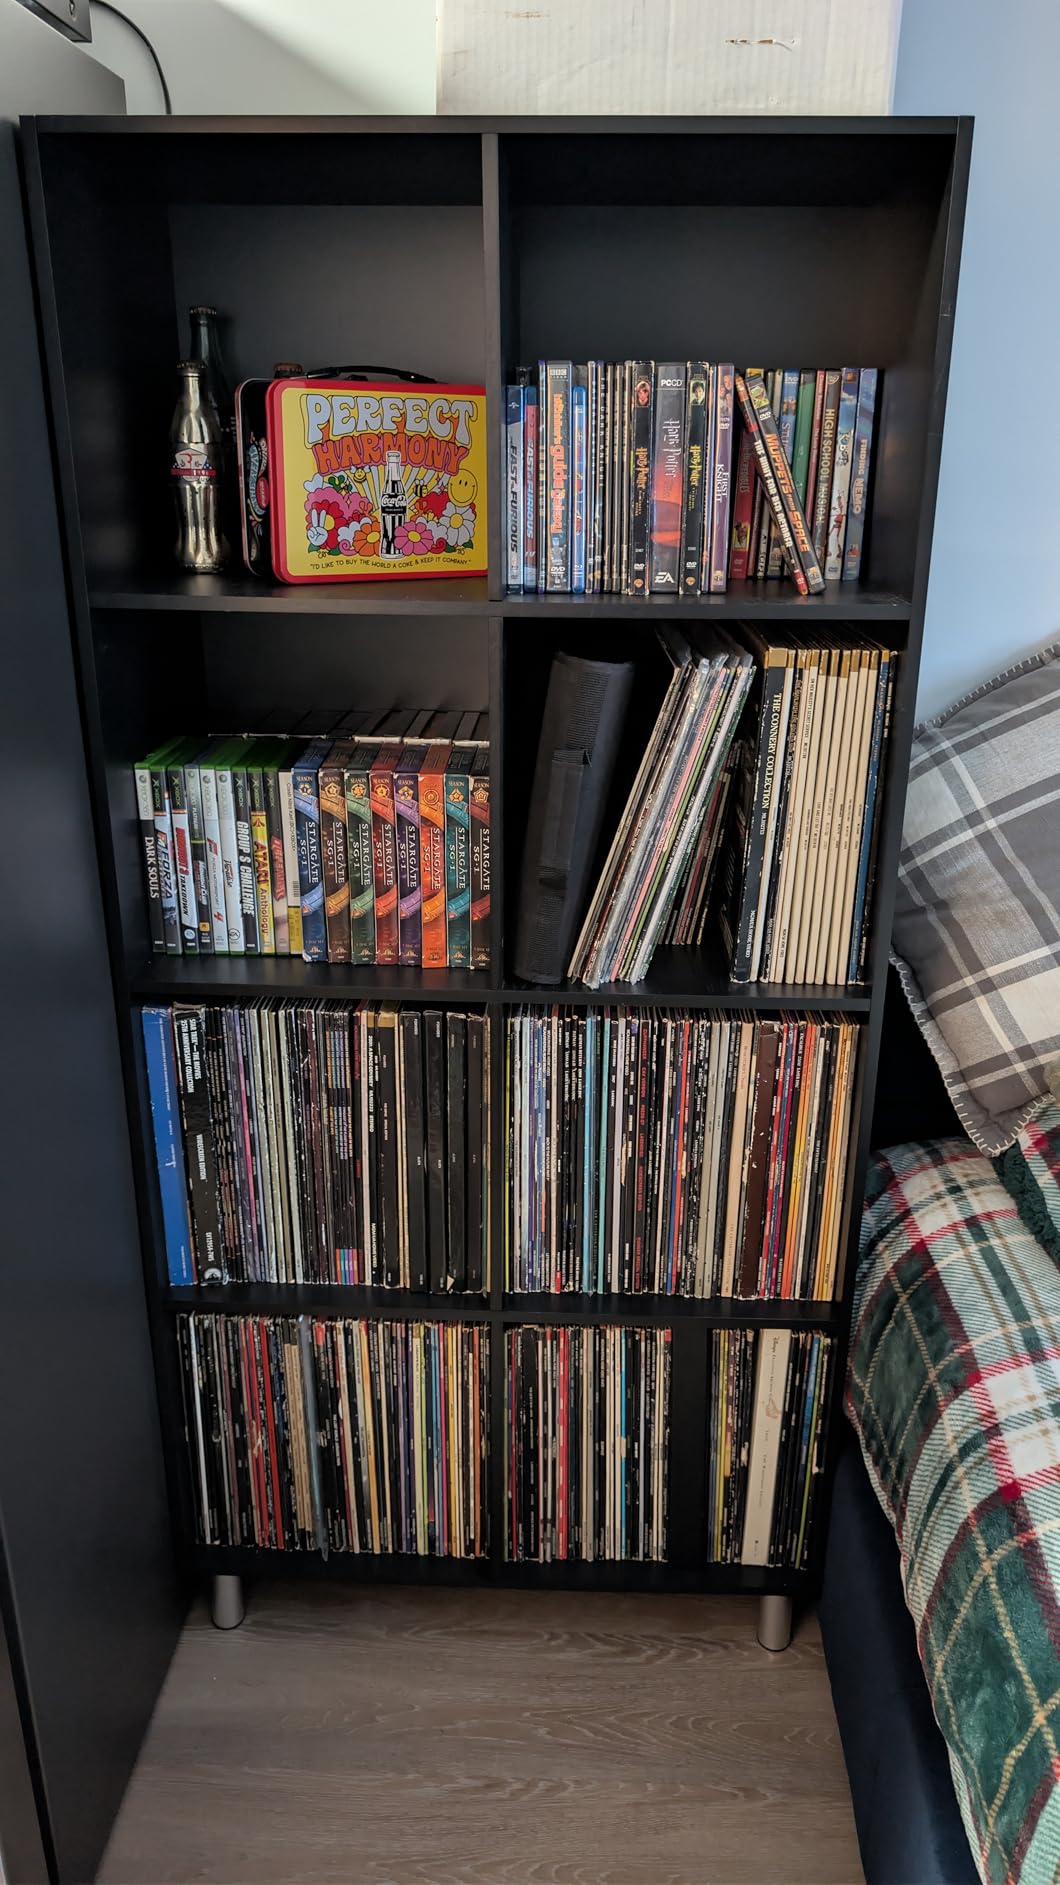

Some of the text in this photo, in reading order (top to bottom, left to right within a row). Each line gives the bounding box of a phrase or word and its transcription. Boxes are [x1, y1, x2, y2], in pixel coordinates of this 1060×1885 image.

[302, 394, 475, 447] PERFECT
[663, 419, 681, 478] Harry Potter
[312, 433, 469, 476] HARMONY
[550, 445, 568, 489] guide
[715, 464, 724, 503] KNIGHT
[721, 472, 730, 498] FIRST
[816, 408, 836, 526] HIGH SCHOOL MUSICAL
[852, 439, 868, 514] FINDING NEMO
[509, 489, 518, 553] FURIOUS
[765, 433, 794, 494] MUPPETS
[789, 510, 809, 553] SPACE
[372, 561, 391, 569] WORLD
[654, 572, 674, 583] EA
[769, 711, 781, 753] CONNERY
[774, 693, 782, 711] THE
[761, 755, 776, 809] COLLECTION
[144, 837, 160, 899] DARK SOULS
[162, 851, 173, 900] FORZA
[236, 821, 254, 915] GROUP S CHALLENGE
[308, 822, 318, 884] STARGATE
[335, 822, 345, 884] STARGATE
[361, 823, 371, 886] STARGATE
[384, 824, 394, 886] STARGATE
[407, 826, 417, 888] STARGATE
[432, 827, 440, 890] STARGATE
[457, 827, 466, 889] STARGATE
[482, 828, 490, 891] STARGATE
[180, 875, 189, 915] TAKEDOWN
[254, 841, 270, 935] ATARI Anthology
[181, 1019, 194, 1093] 25TH ANNIVERSARY COLLECTION
[196, 1134, 205, 1161] WIDESCREEN
